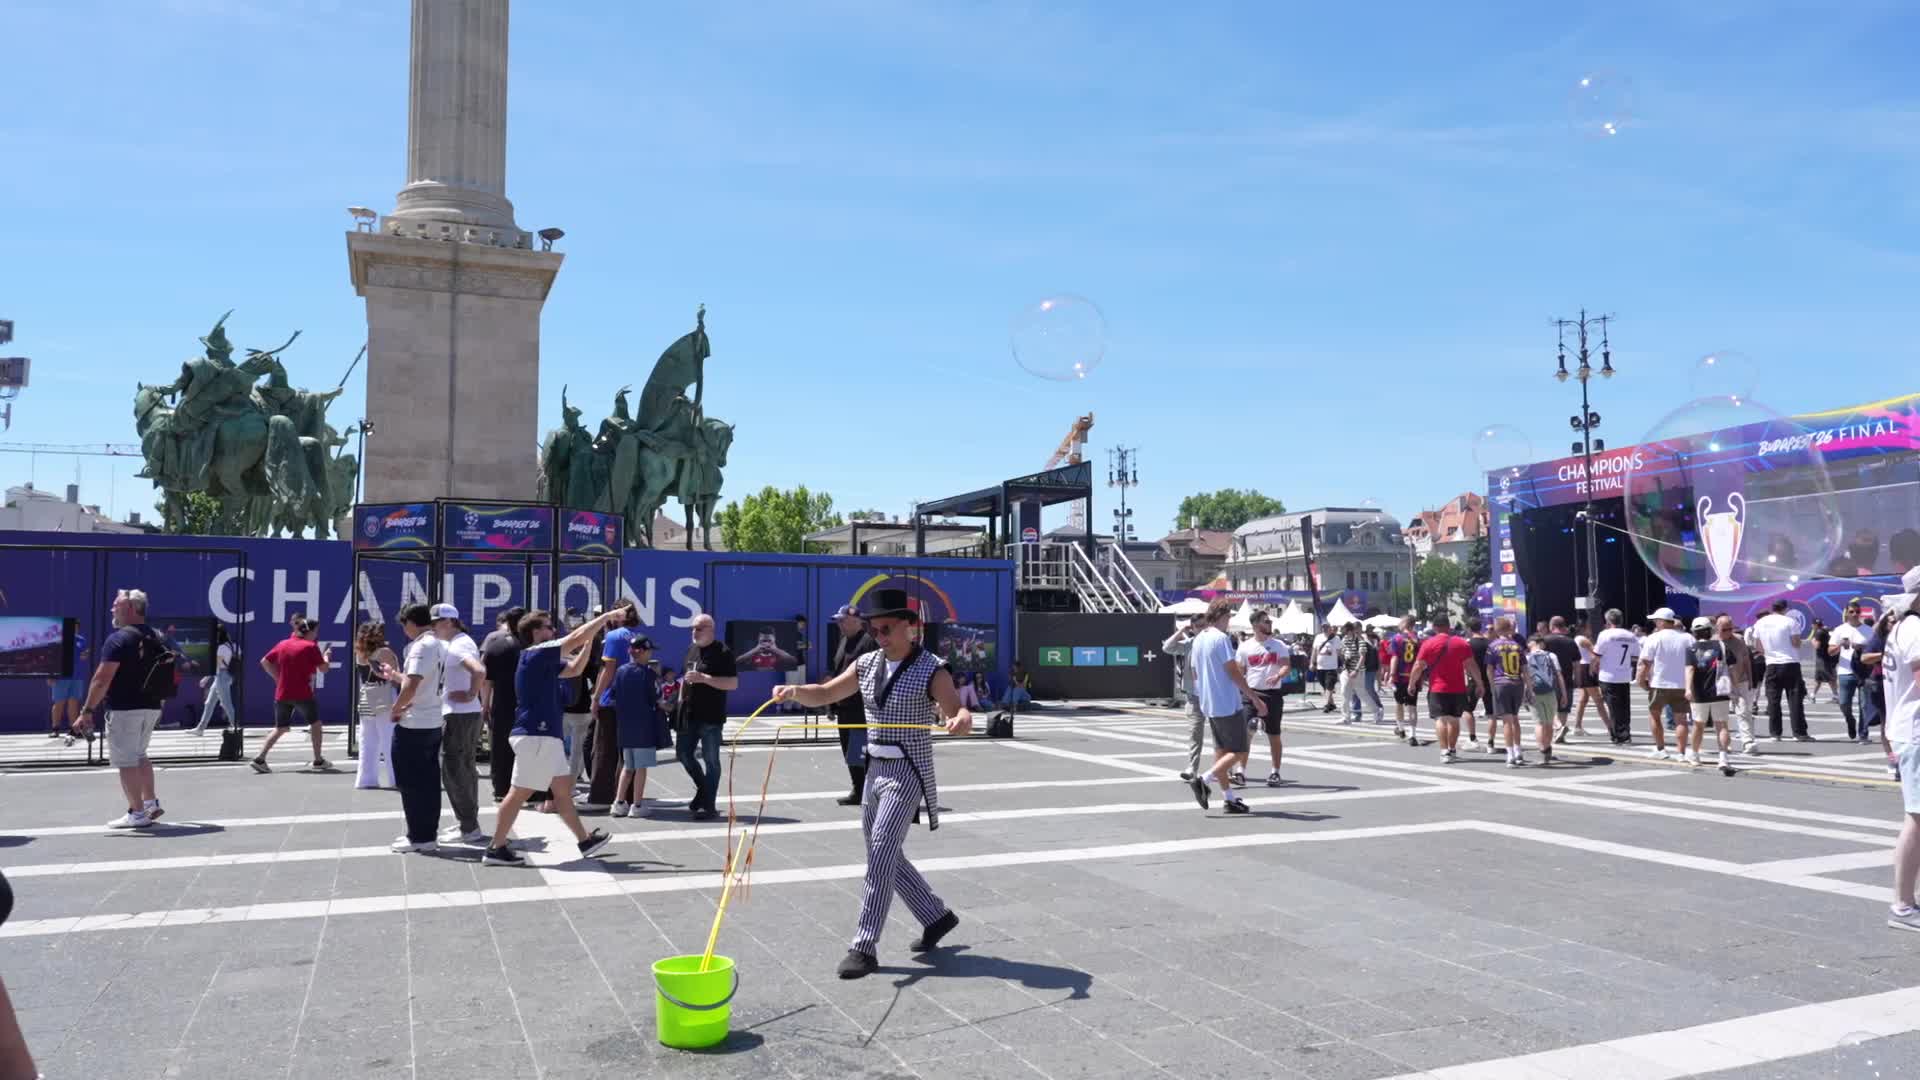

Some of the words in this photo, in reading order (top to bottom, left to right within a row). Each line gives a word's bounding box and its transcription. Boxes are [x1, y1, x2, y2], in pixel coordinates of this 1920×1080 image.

[1758, 432, 1816, 456] BUDAPEST
[1839, 420, 1899, 441] FINAL
[1558, 452, 1644, 481] CHAMPIONS
[1576, 476, 1624, 494] FESTIVAL
[1403, 641, 1415, 663] 8
[1499, 651, 1521, 675] 10
[1619, 644, 1630, 666] 7
